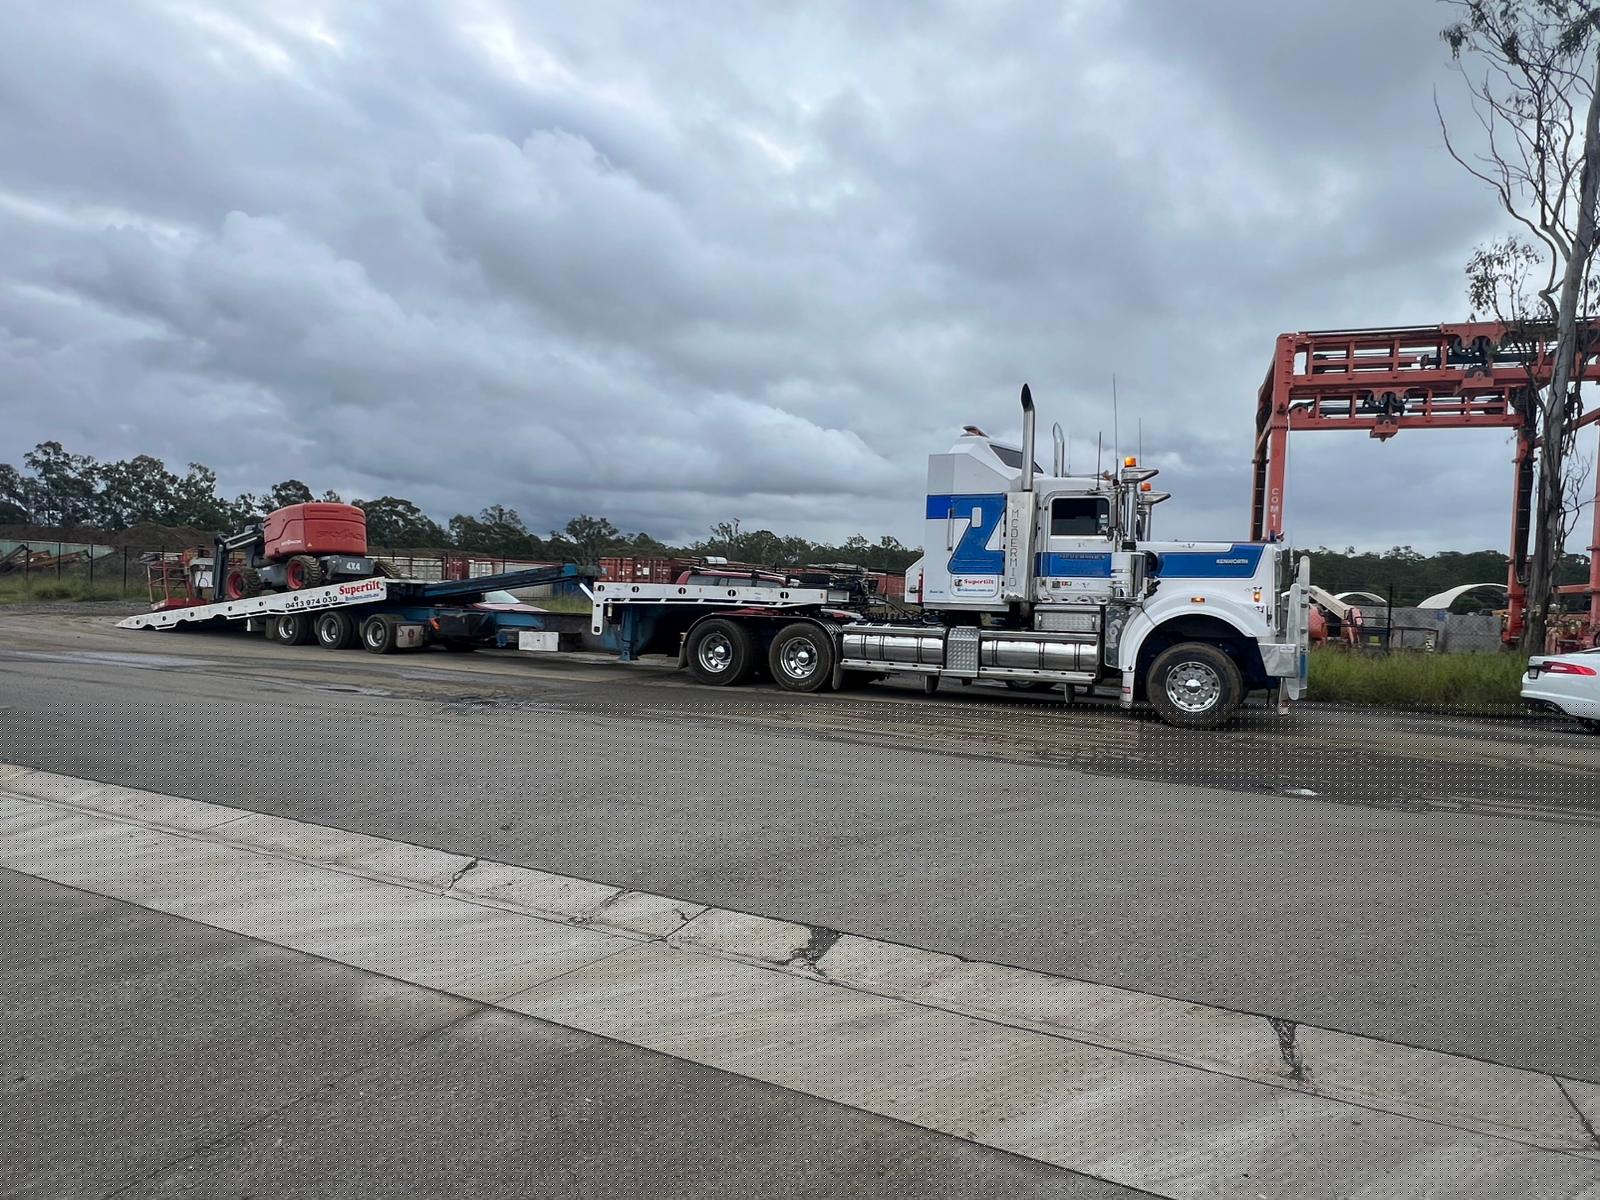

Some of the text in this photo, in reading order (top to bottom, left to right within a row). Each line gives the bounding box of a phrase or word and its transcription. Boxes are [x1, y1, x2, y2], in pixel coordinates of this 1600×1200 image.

[345, 562, 361, 571] 4X4
[338, 579, 381, 596] Supertilt
[285, 595, 338, 609] 0413 974 030
